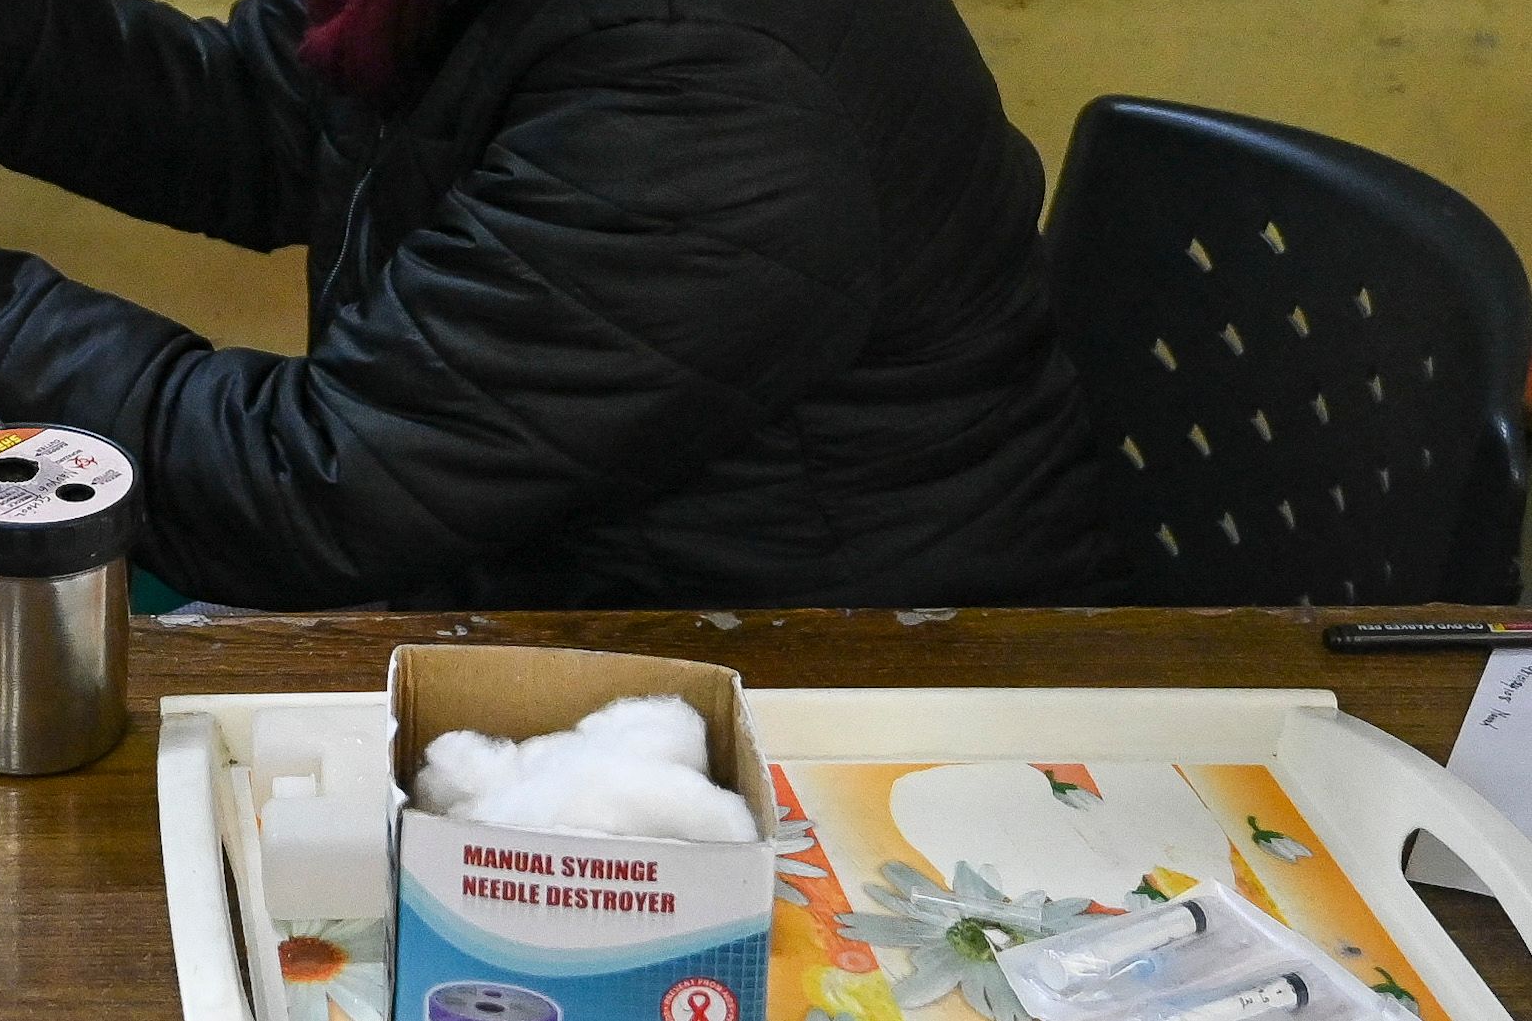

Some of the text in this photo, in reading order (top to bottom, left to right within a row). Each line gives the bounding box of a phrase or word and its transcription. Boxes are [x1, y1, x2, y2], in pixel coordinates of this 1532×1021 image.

[463, 844, 658, 882] MANUAL SYRINGE
[462, 875, 676, 914] NEEDLE DESTROYER
